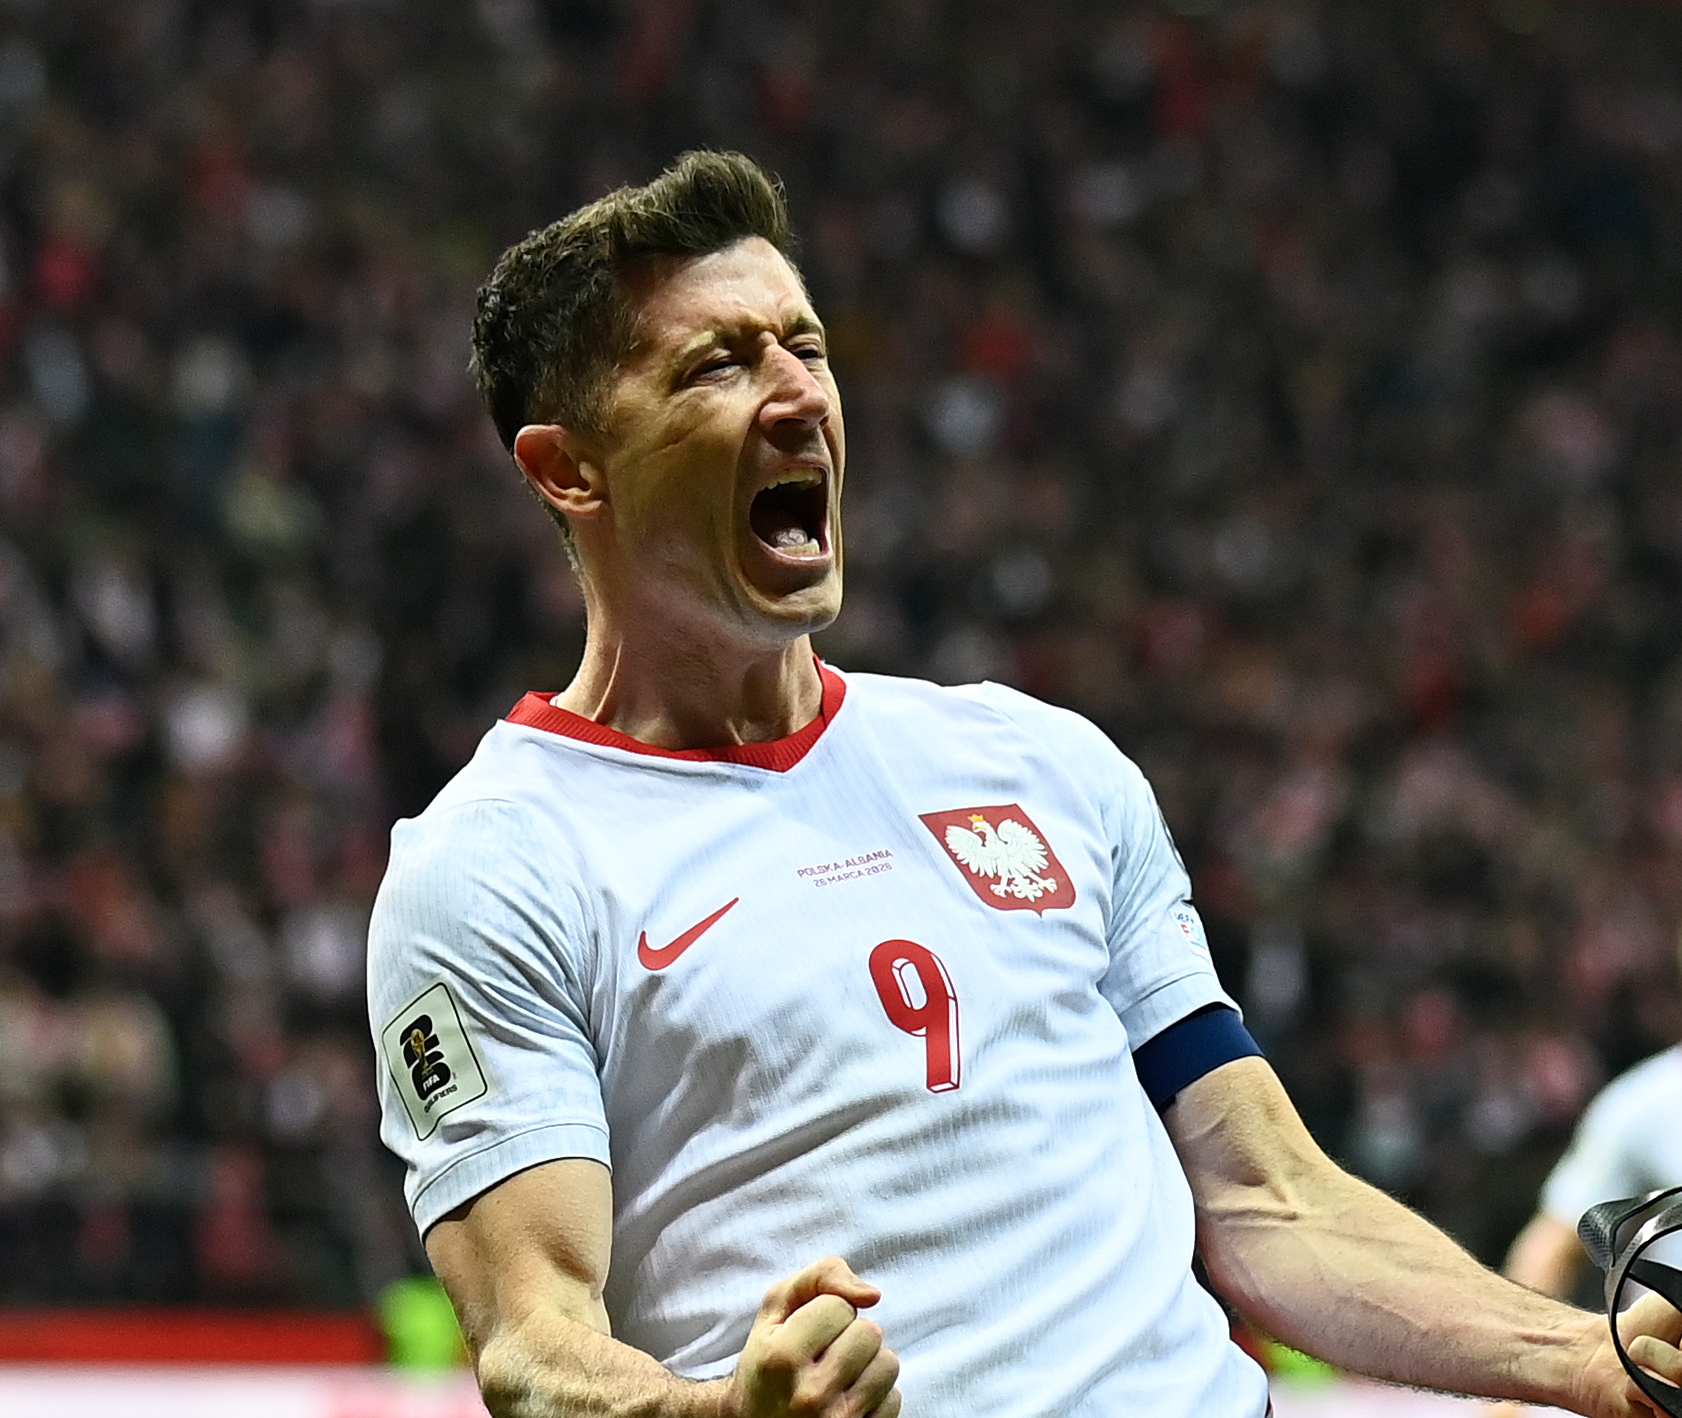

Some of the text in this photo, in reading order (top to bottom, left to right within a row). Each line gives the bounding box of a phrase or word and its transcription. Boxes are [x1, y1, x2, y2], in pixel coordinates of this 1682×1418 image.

[827, 870, 865, 885] MARCA
[869, 939, 961, 1094] 9
[422, 1074, 441, 1091] FIFA
